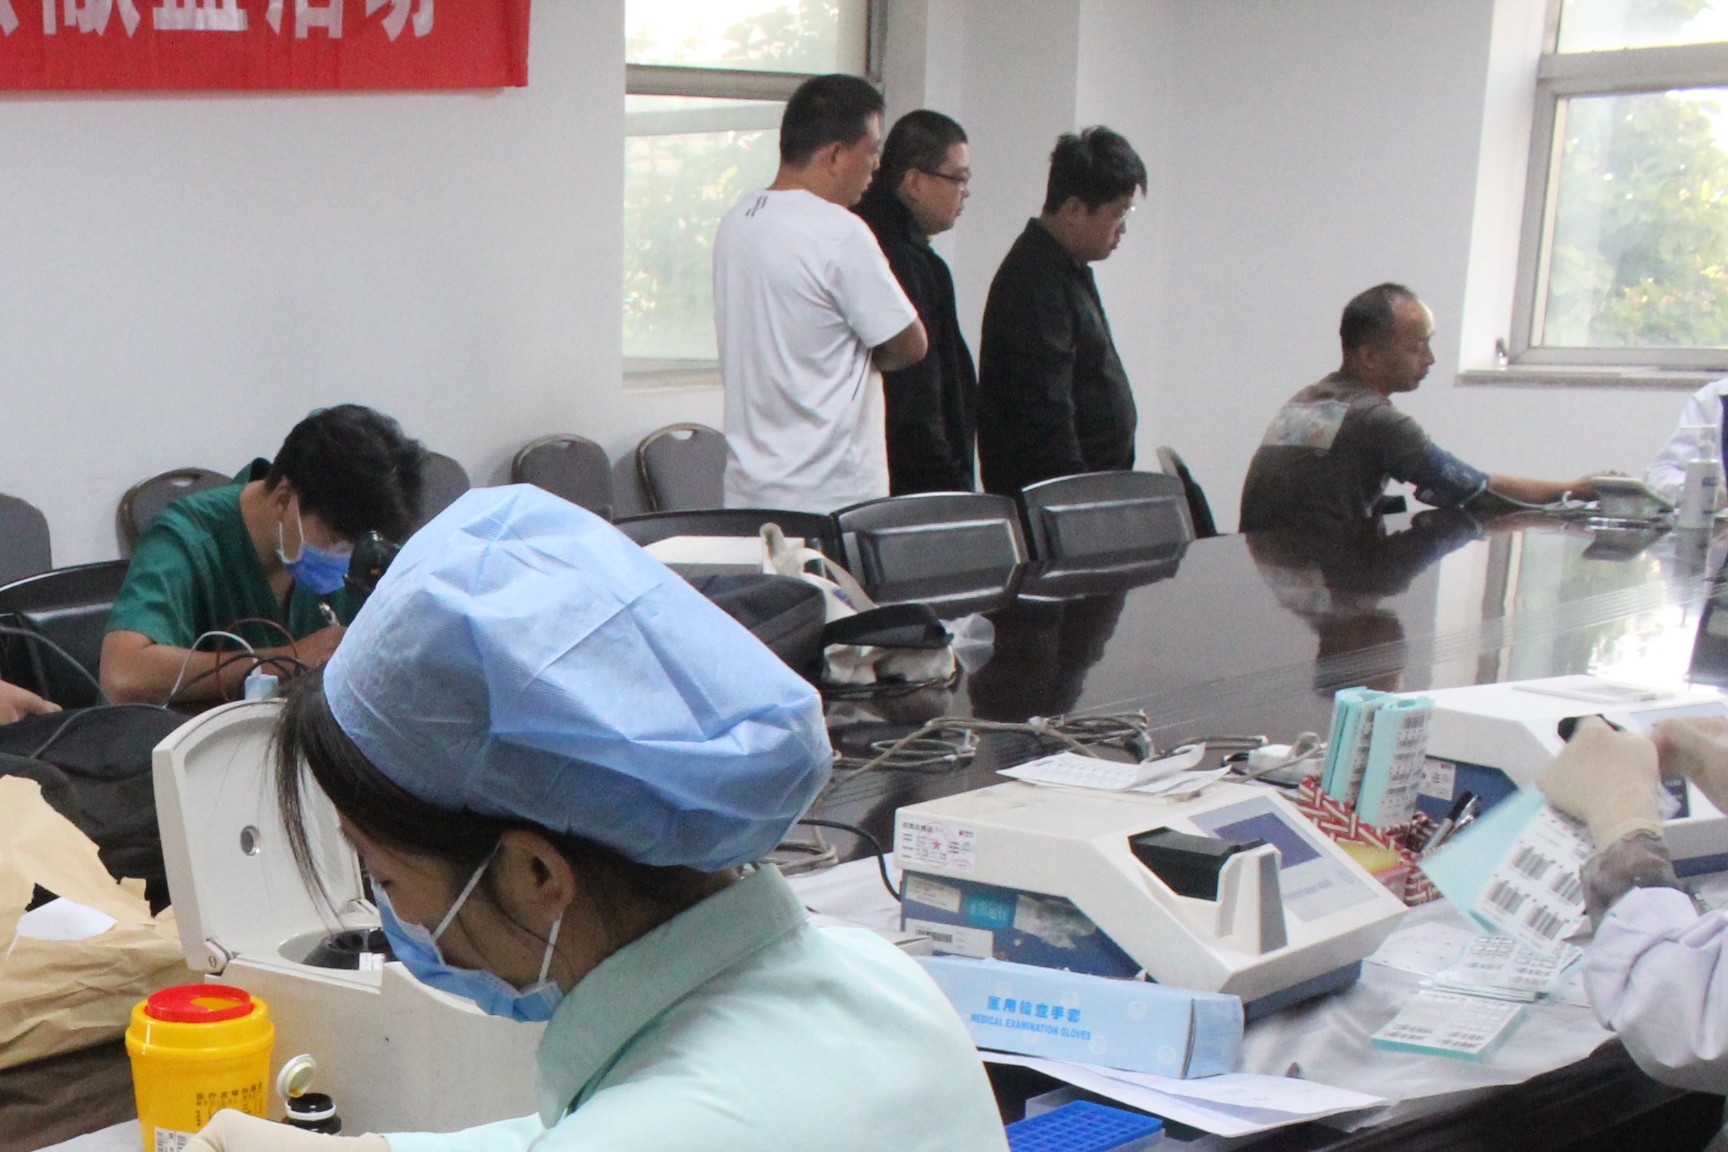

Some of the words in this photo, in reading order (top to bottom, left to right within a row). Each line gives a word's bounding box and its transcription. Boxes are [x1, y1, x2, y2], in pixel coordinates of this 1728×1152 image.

[971, 1013, 1003, 1027] MEDICAL
[1006, 1019, 1059, 1035] EXAMINATION
[1061, 1027, 1091, 1040] GLOVES
